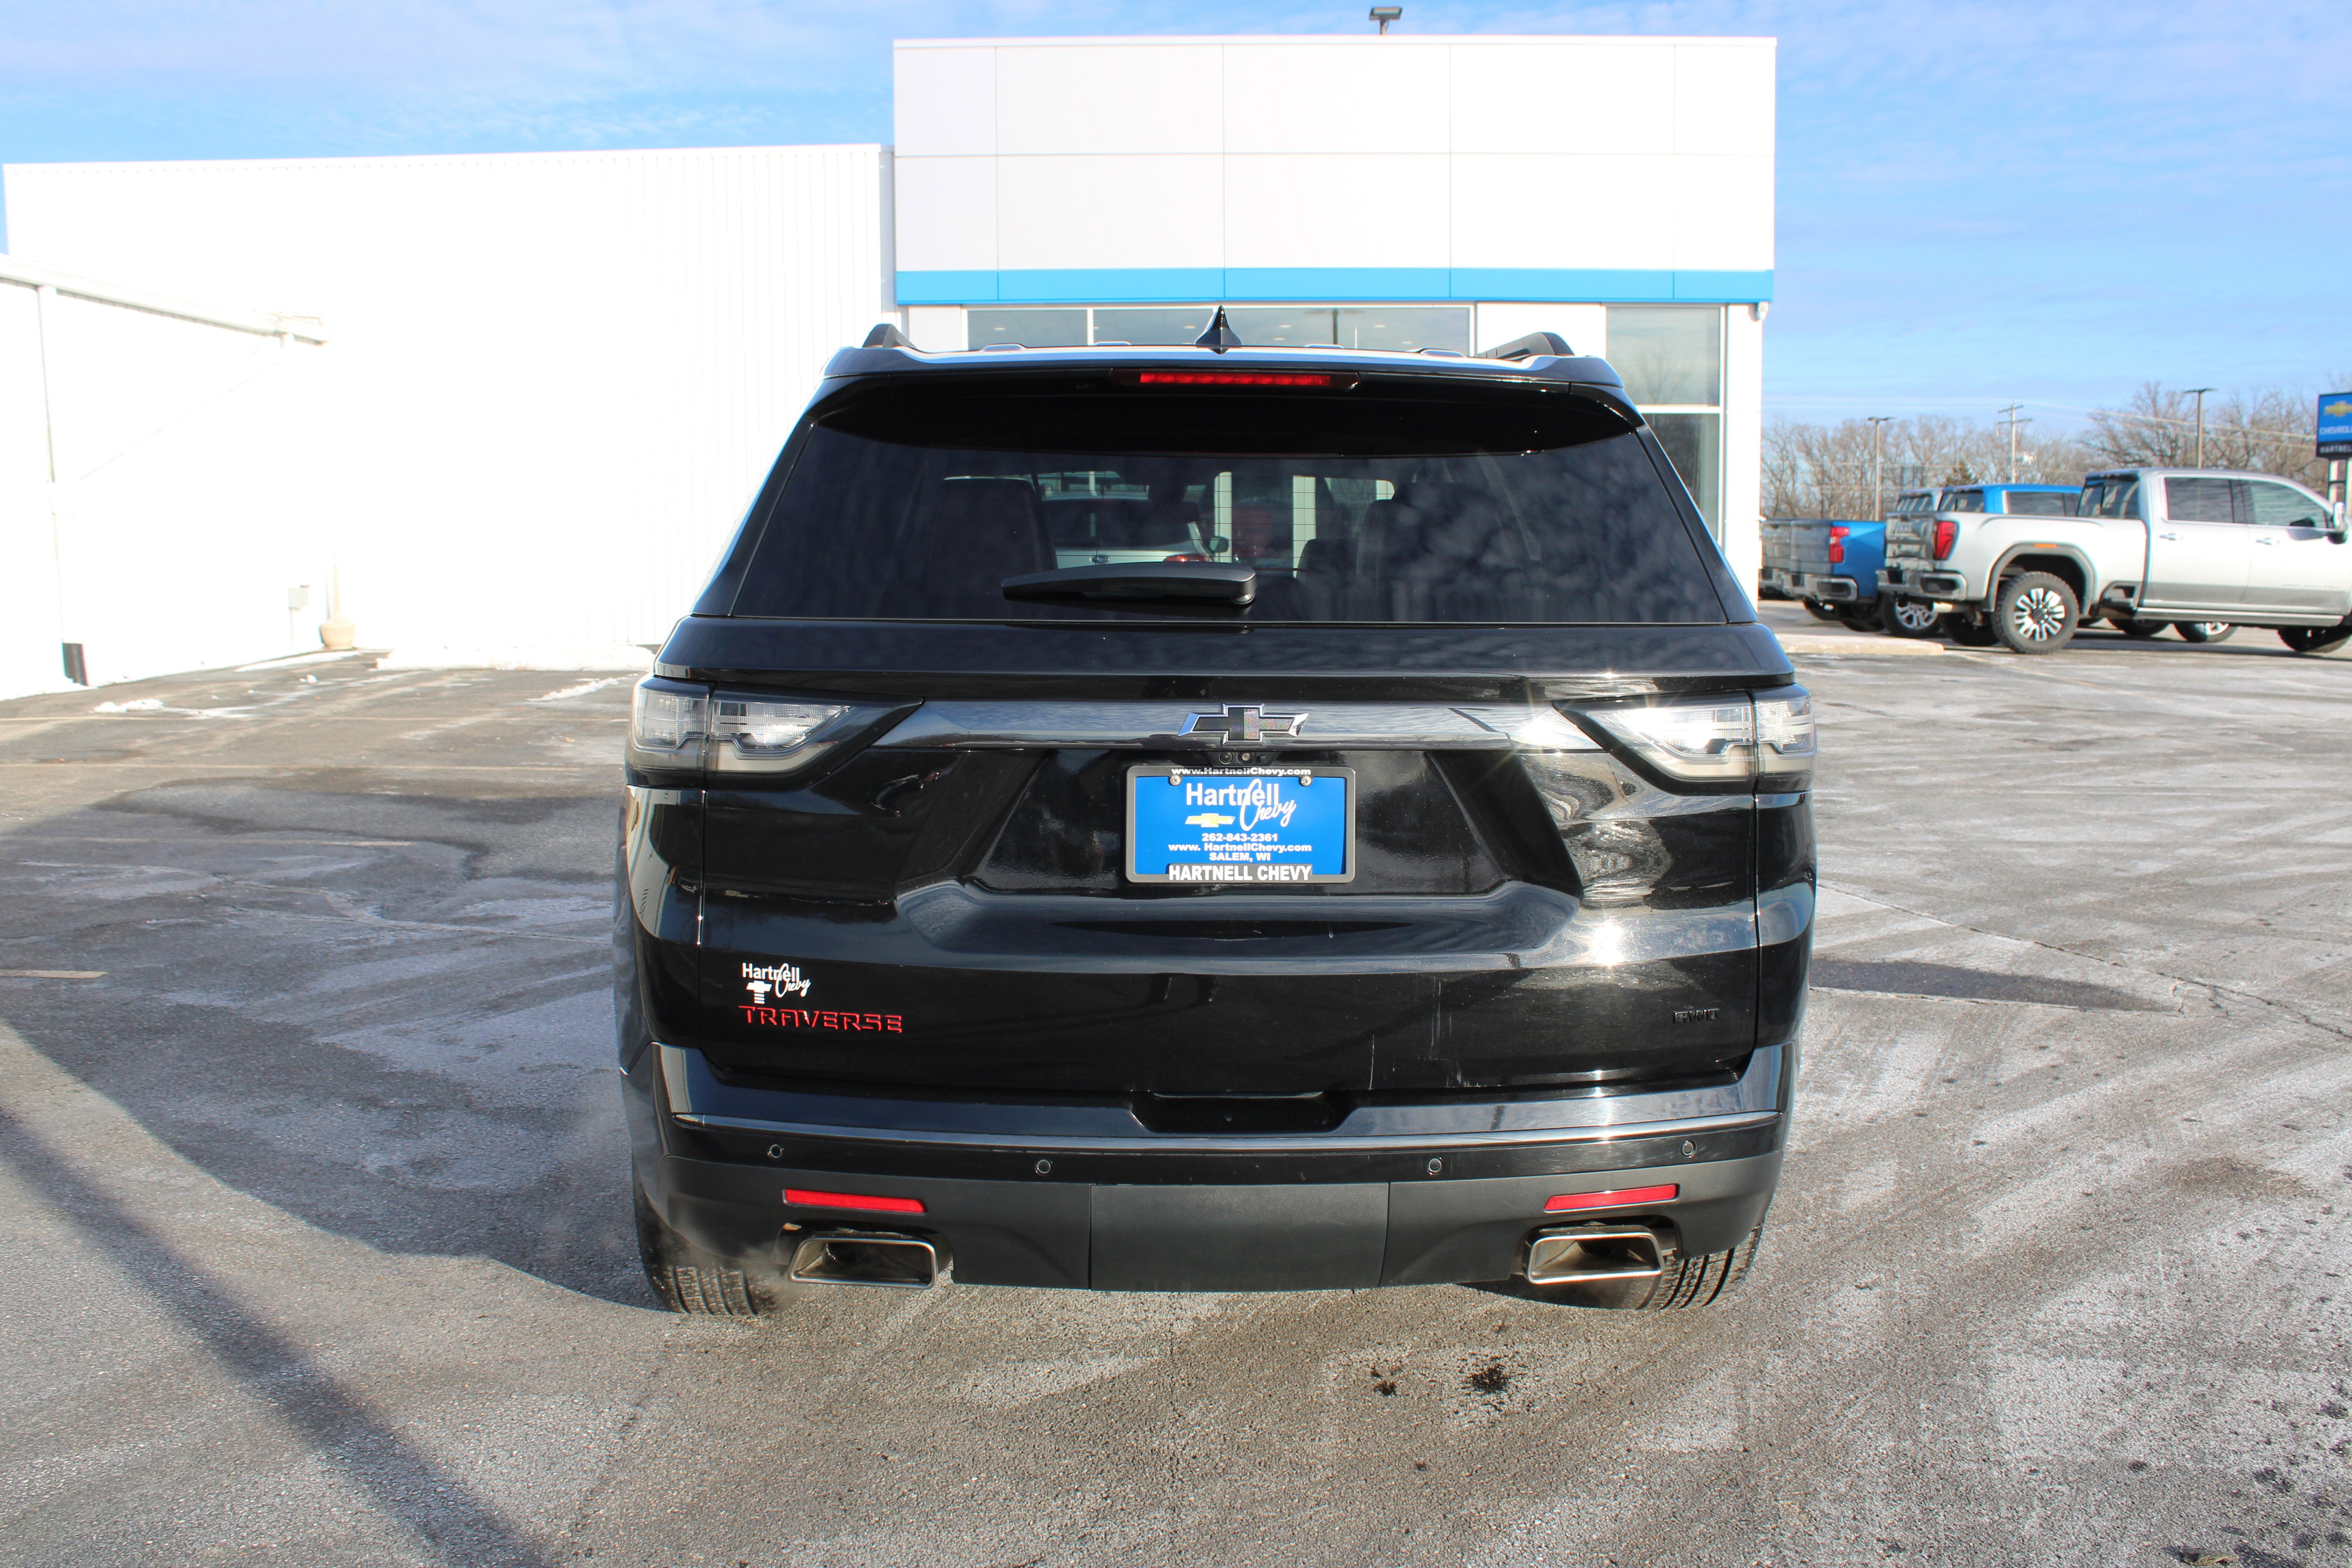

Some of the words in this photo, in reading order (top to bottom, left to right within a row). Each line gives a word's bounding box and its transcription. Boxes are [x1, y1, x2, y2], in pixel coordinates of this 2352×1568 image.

[1187, 783, 1279, 805] Hartnell
[1240, 778, 1296, 831] Chevy
[1202, 833, 1278, 842] 262-843-2361
[1204, 843, 1312, 853] HartnellChevy.com
[1209, 852, 1253, 862] SALEM,
[1256, 852, 1271, 861] WI
[1169, 865, 1253, 881] HARTNELL
[1257, 865, 1312, 881] CHEVY
[742, 962, 800, 982] Hartnell
[738, 1005, 902, 1033] TRAVERSE
